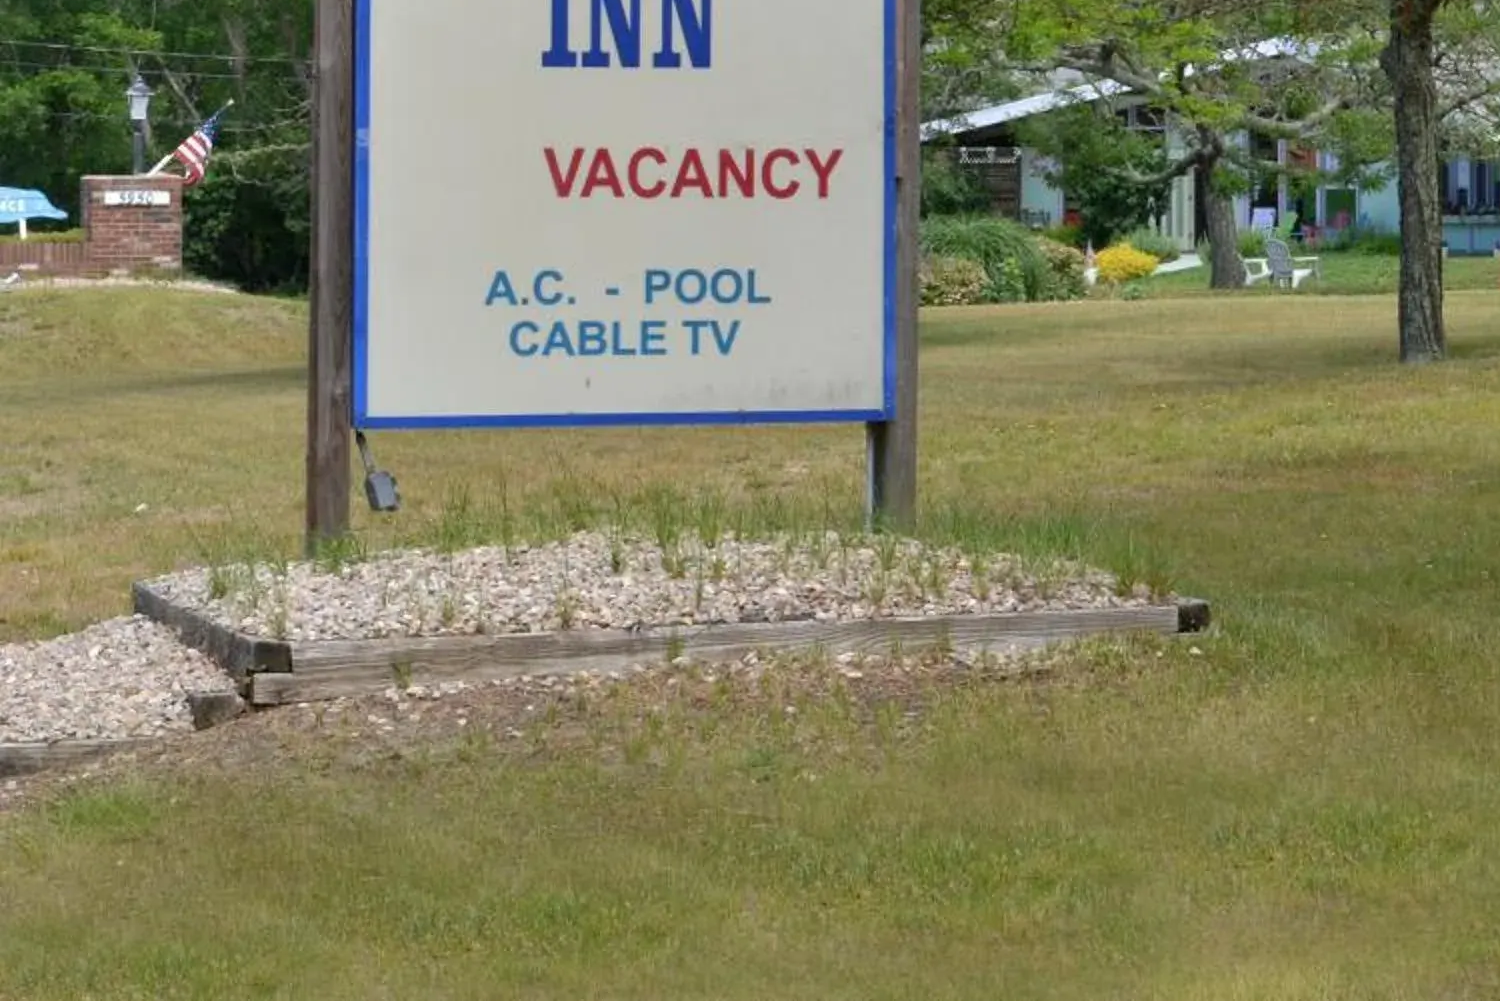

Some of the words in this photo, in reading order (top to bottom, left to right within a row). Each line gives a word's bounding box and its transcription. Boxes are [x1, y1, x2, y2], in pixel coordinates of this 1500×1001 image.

[544, 148, 843, 199] VACANCY
[485, 270, 575, 306] A.C.
[645, 269, 771, 304] POOL
[510, 321, 667, 356] CABLE
[682, 320, 740, 355] TV
